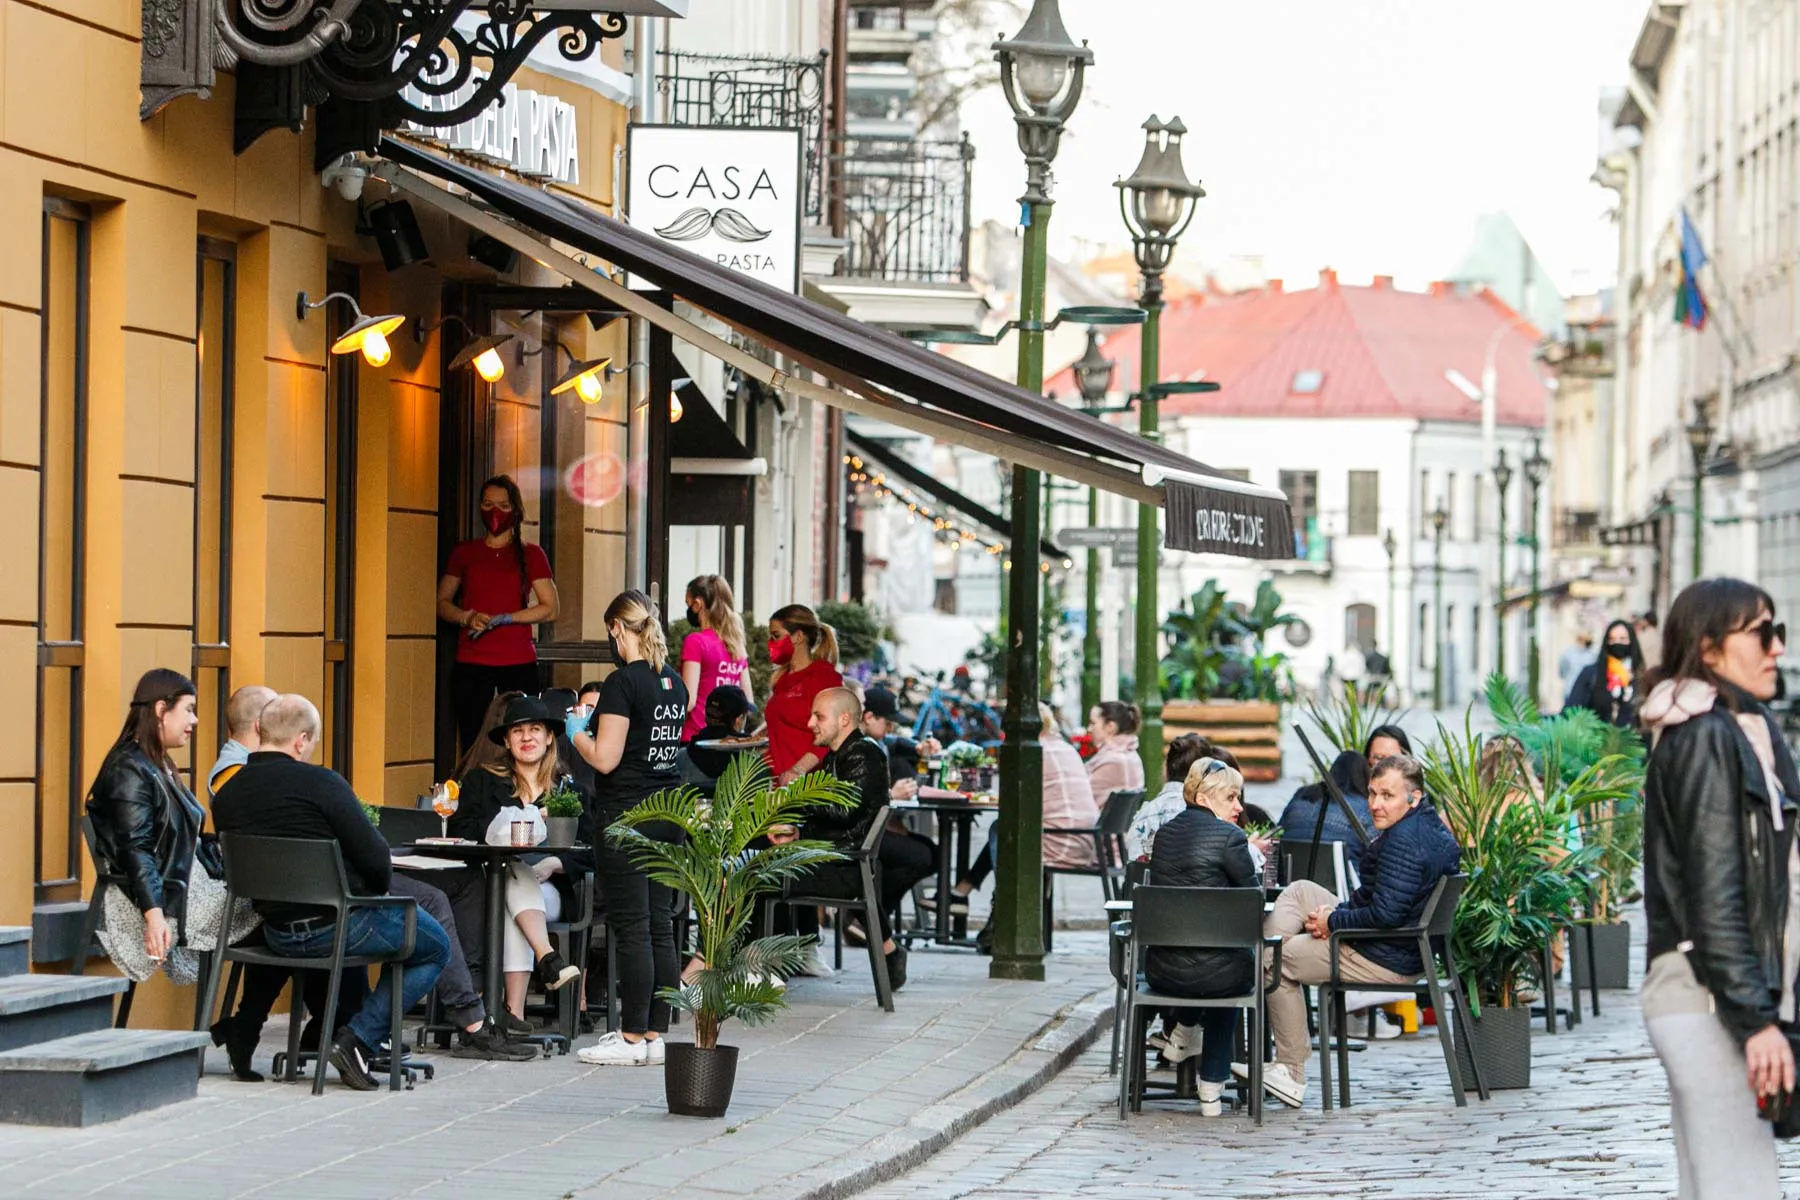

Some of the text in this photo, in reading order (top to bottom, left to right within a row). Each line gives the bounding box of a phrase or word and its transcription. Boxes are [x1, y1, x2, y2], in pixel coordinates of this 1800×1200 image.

[529, 90, 580, 185] PASTA
[648, 164, 778, 201] CASA
[716, 253, 776, 271] PASTA
[718, 660, 744, 675] CASA
[653, 703, 686, 721] CASA
[650, 725, 683, 742] DELLA
[647, 745, 680, 762] PASTA
